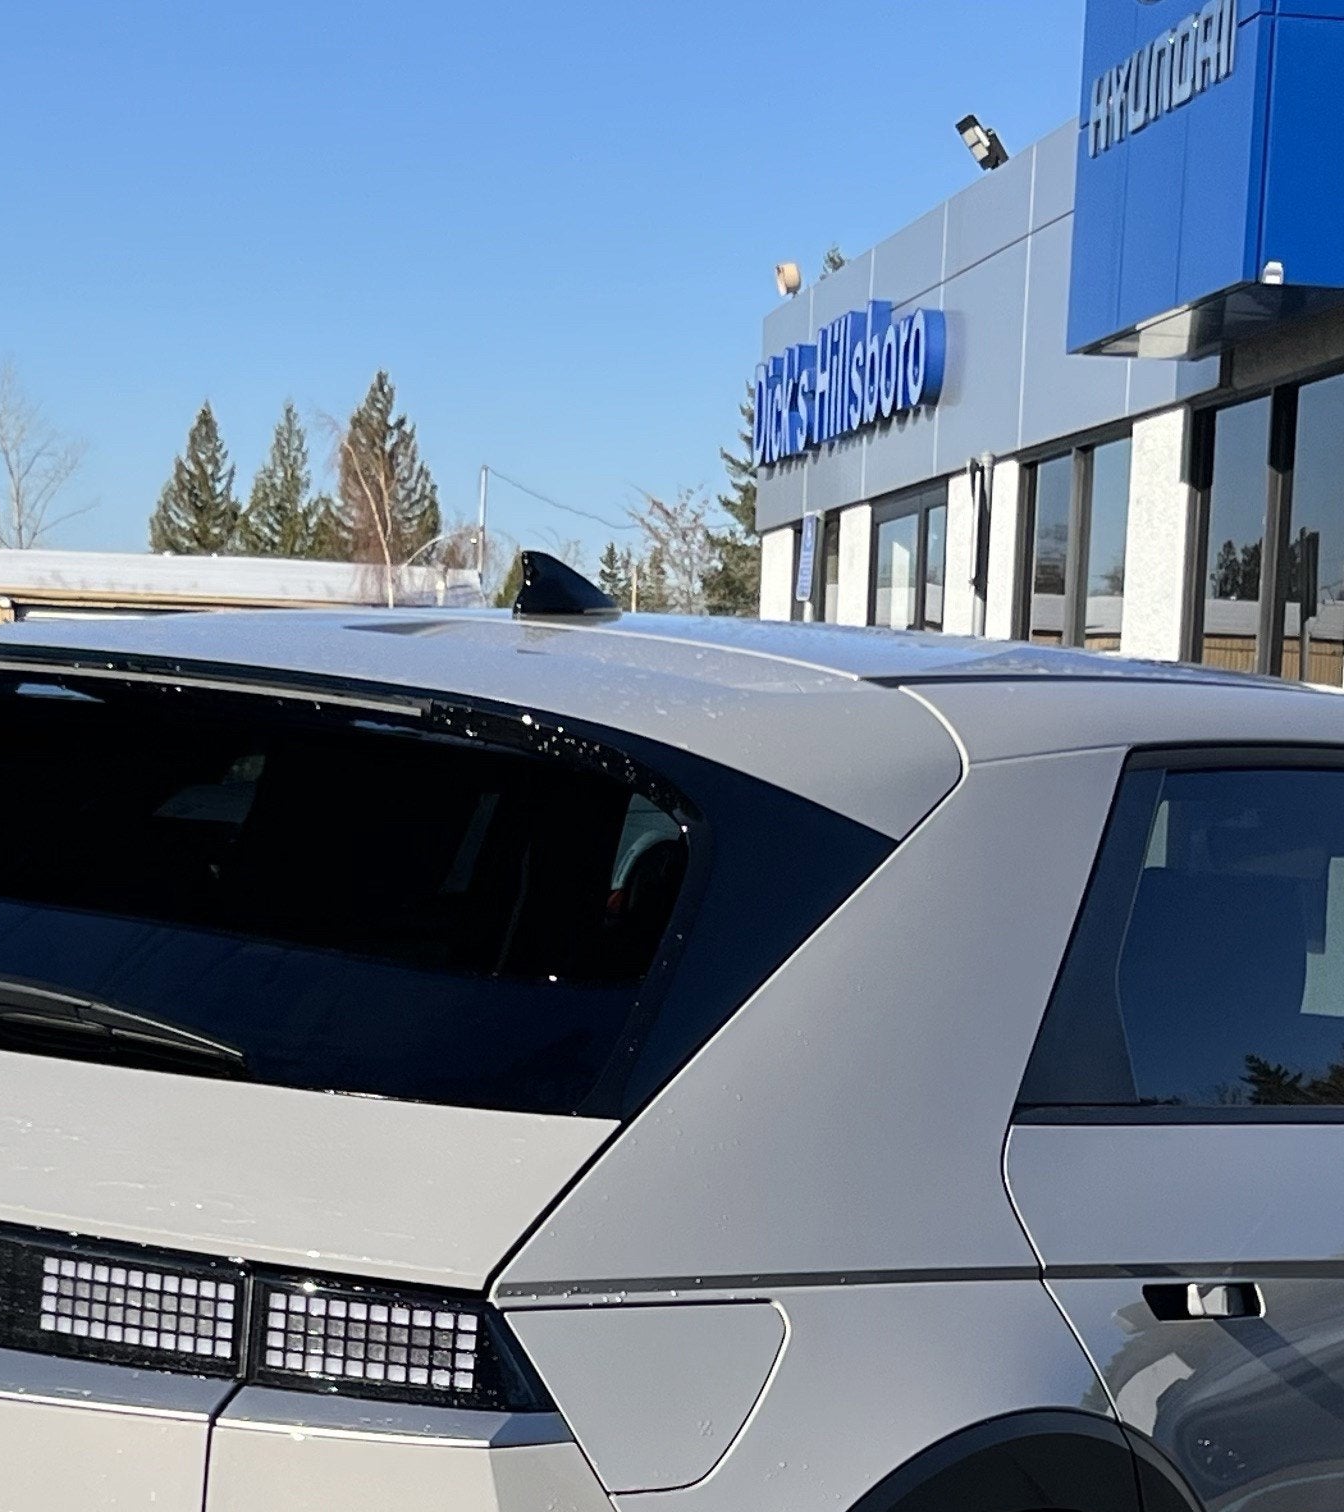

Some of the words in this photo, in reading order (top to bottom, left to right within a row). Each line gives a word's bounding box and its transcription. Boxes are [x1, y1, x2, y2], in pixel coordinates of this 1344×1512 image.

[1089, 0, 1235, 158] HYUNDAI
[754, 345, 812, 466] Dick's
[814, 300, 928, 443] Hillsboro
